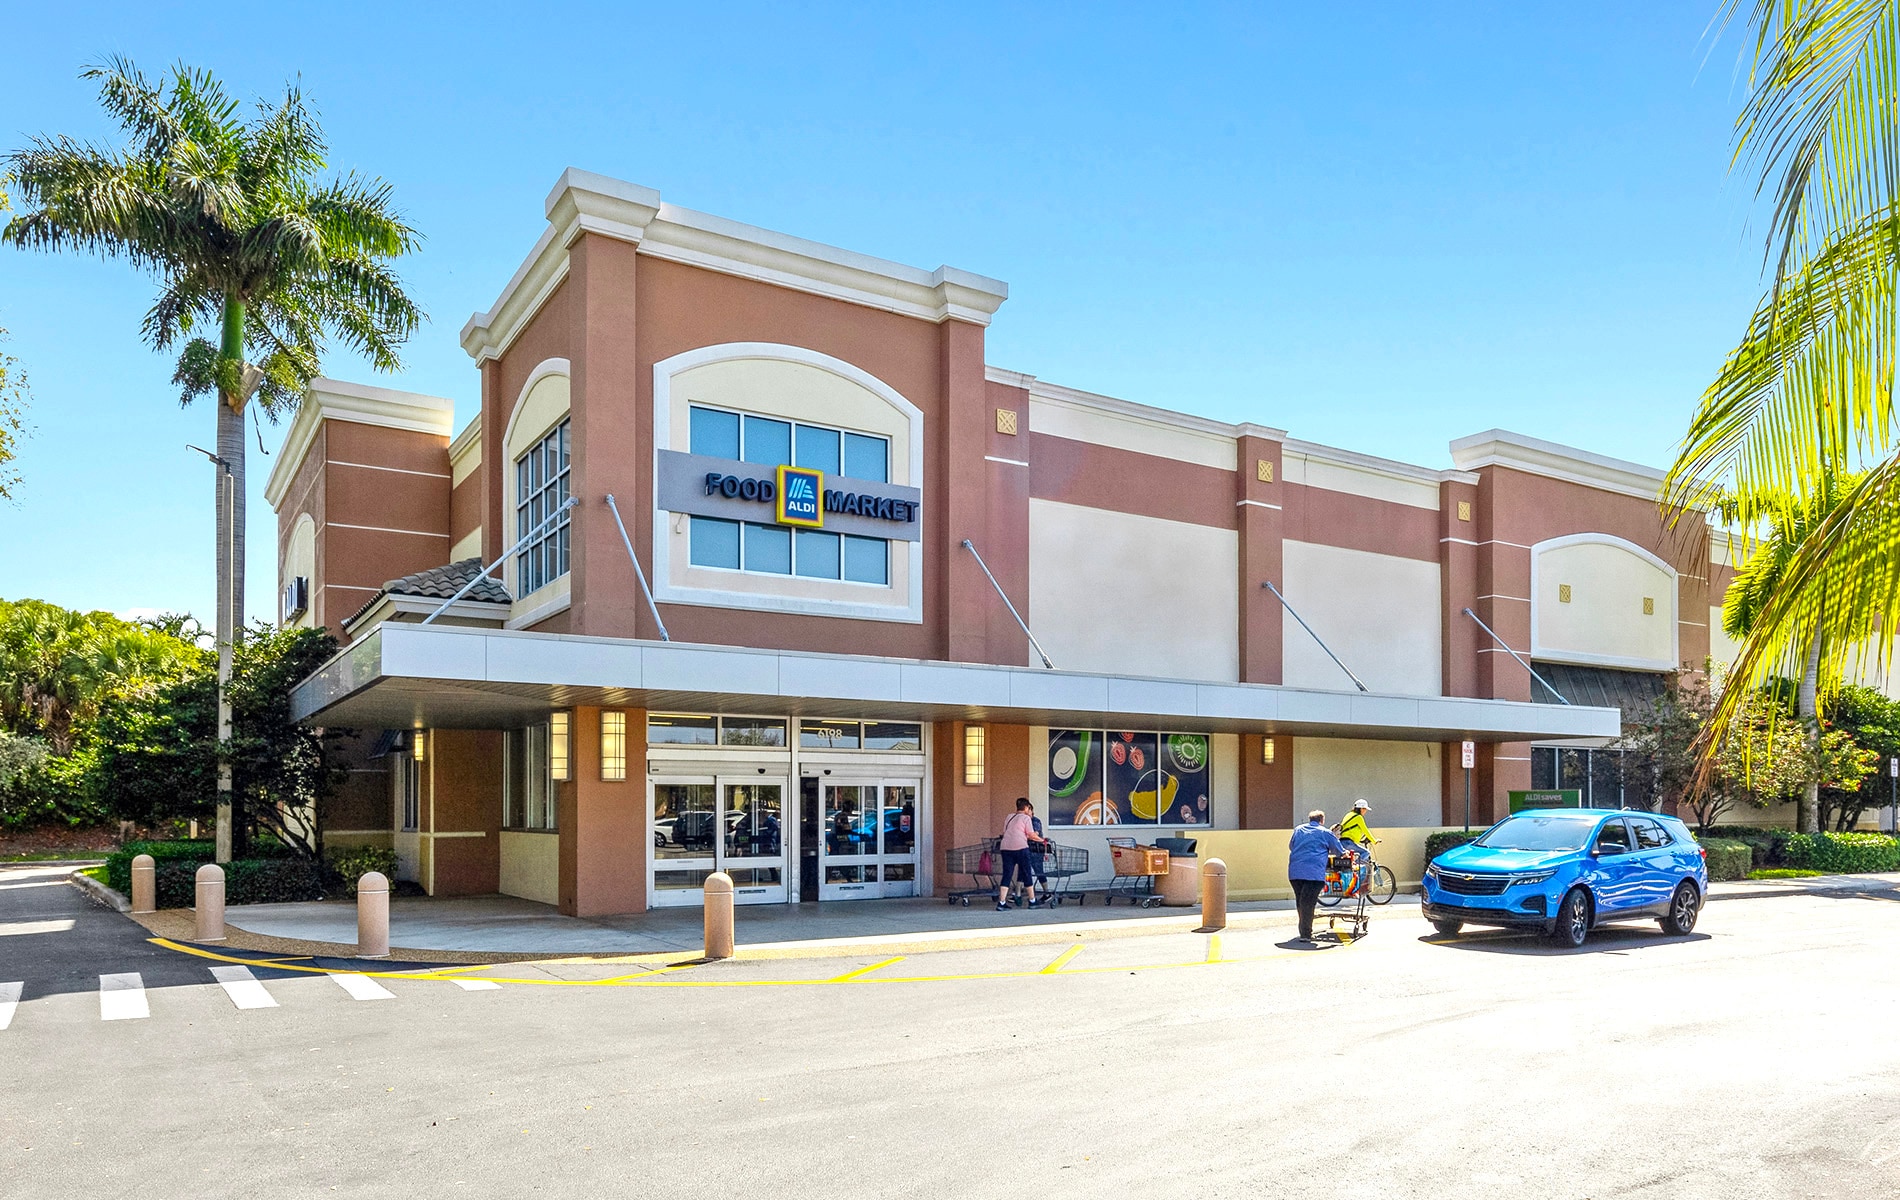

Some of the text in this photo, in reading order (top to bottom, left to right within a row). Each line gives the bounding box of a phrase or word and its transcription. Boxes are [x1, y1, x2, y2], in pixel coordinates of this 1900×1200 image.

[705, 472, 920, 523] FOOD ALDI MARKET
[817, 728, 843, 739] 6198
